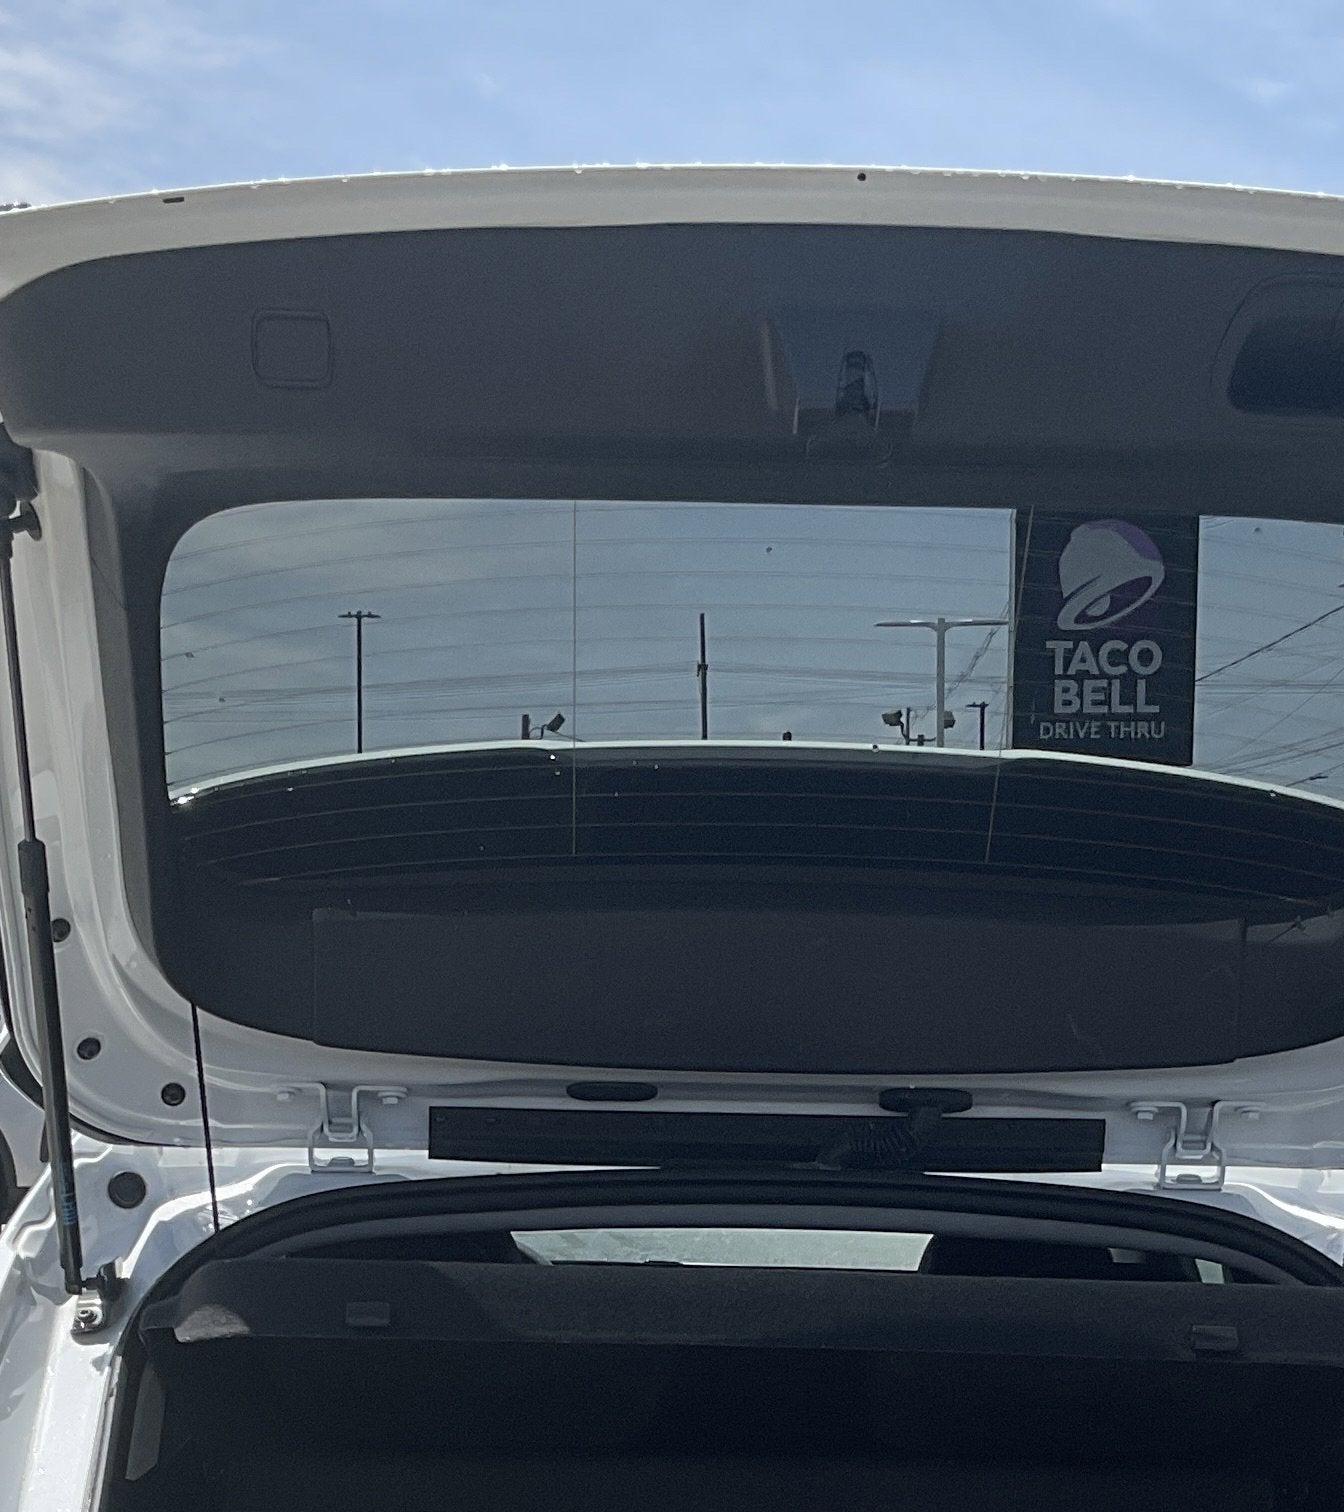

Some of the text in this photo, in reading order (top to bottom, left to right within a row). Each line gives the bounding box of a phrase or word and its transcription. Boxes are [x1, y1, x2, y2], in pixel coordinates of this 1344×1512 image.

[1045, 639, 1163, 676] TACO
[1053, 678, 1160, 714] BELL
[1039, 721, 1166, 740] DRIVE THRU
